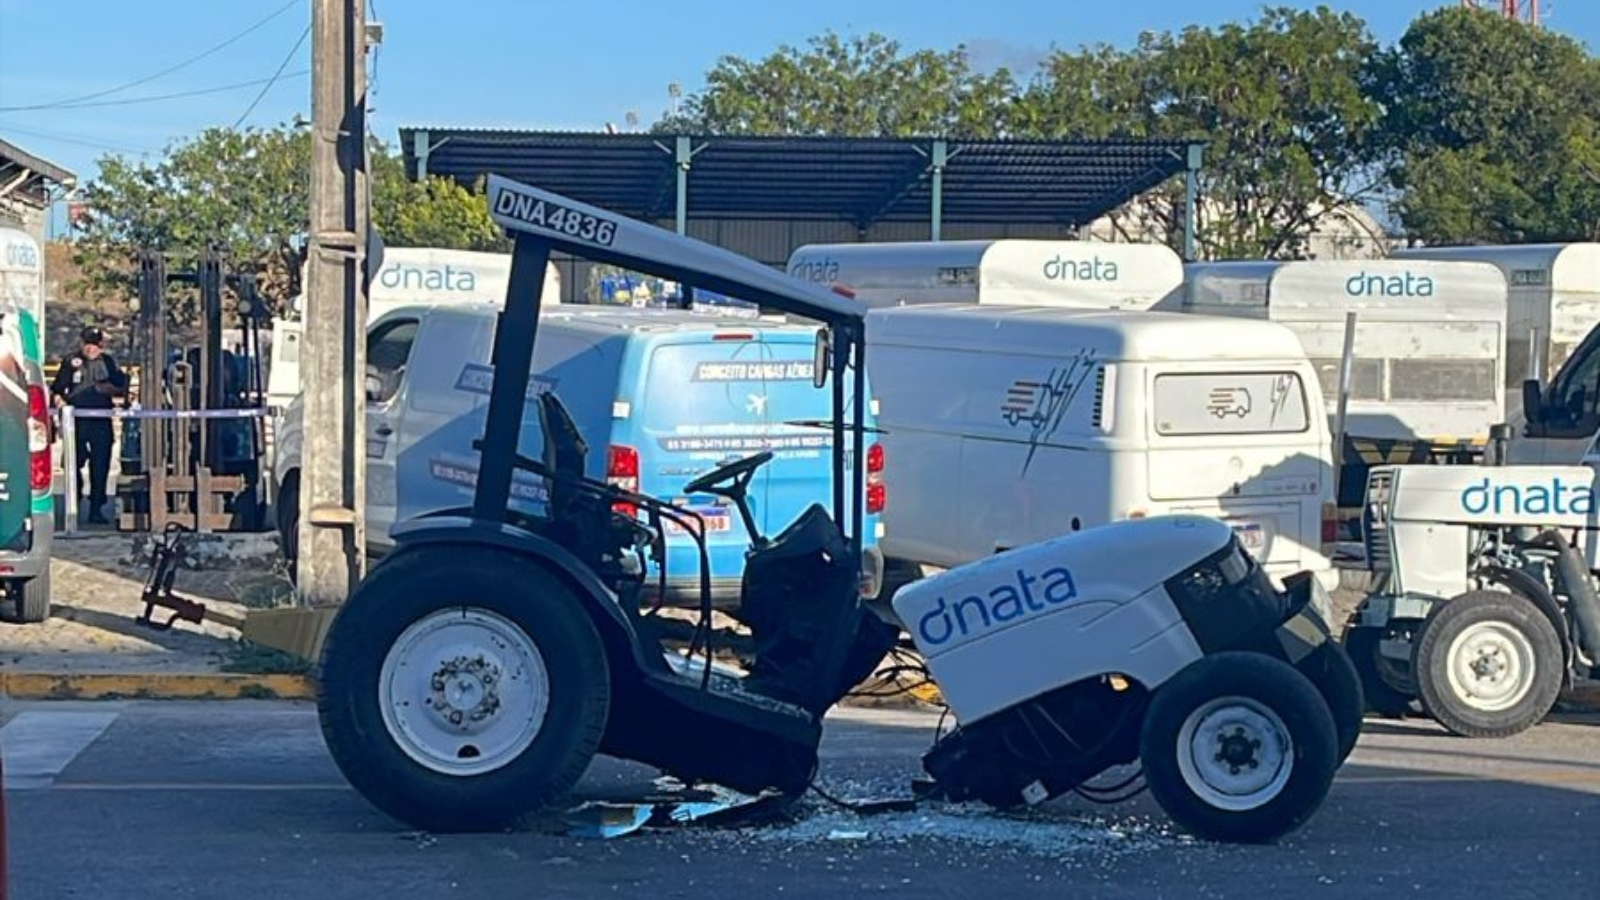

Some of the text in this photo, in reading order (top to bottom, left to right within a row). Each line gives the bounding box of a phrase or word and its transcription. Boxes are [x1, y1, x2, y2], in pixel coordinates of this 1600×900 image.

[497, 190, 614, 245] DNA4836
[381, 264, 475, 291] dnata
[792, 257, 840, 283] dnata
[1043, 254, 1117, 281] dnata
[1346, 271, 1433, 297] dnata
[1462, 477, 1595, 514] dnata
[919, 567, 1077, 645] dnata
